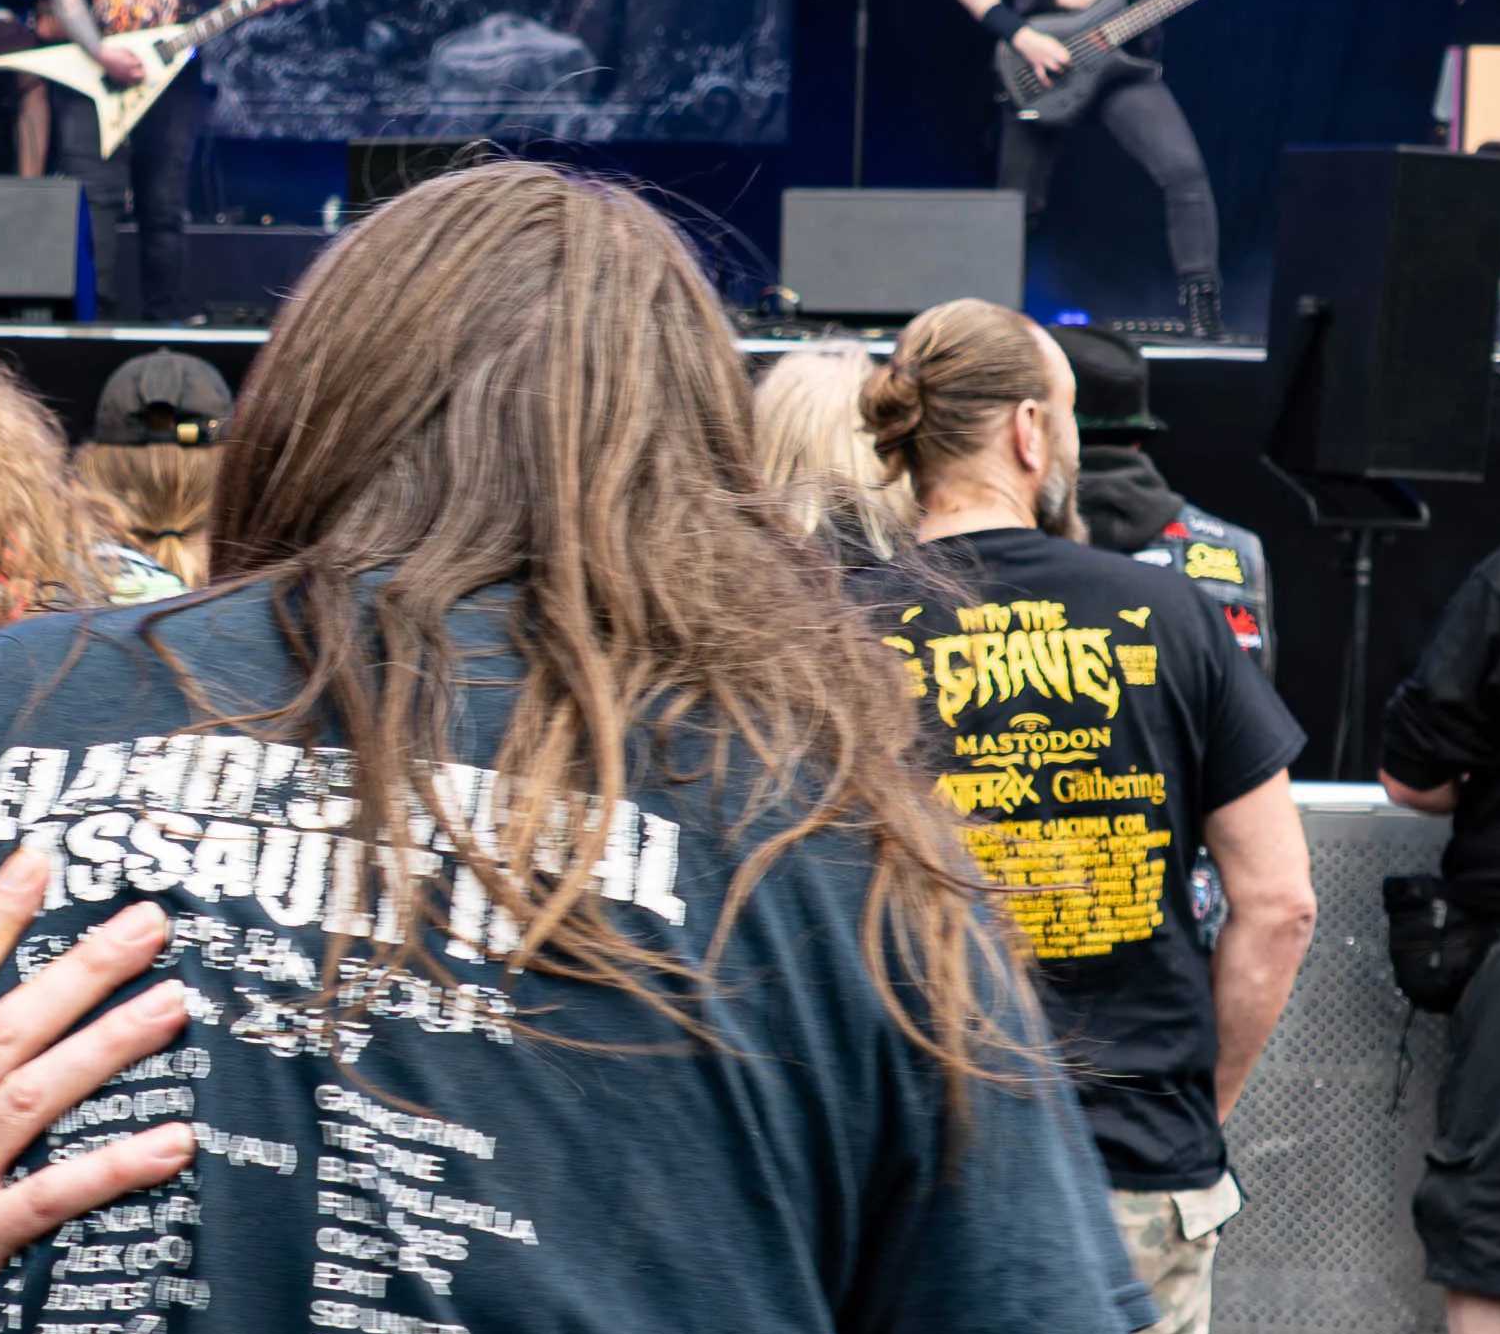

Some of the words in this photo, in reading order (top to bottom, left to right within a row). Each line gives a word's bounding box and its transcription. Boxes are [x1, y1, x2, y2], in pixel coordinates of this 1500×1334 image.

[1010, 600, 1068, 632] THE
[925, 628, 1120, 728] GRAVE
[955, 727, 1112, 756] MASTODON
